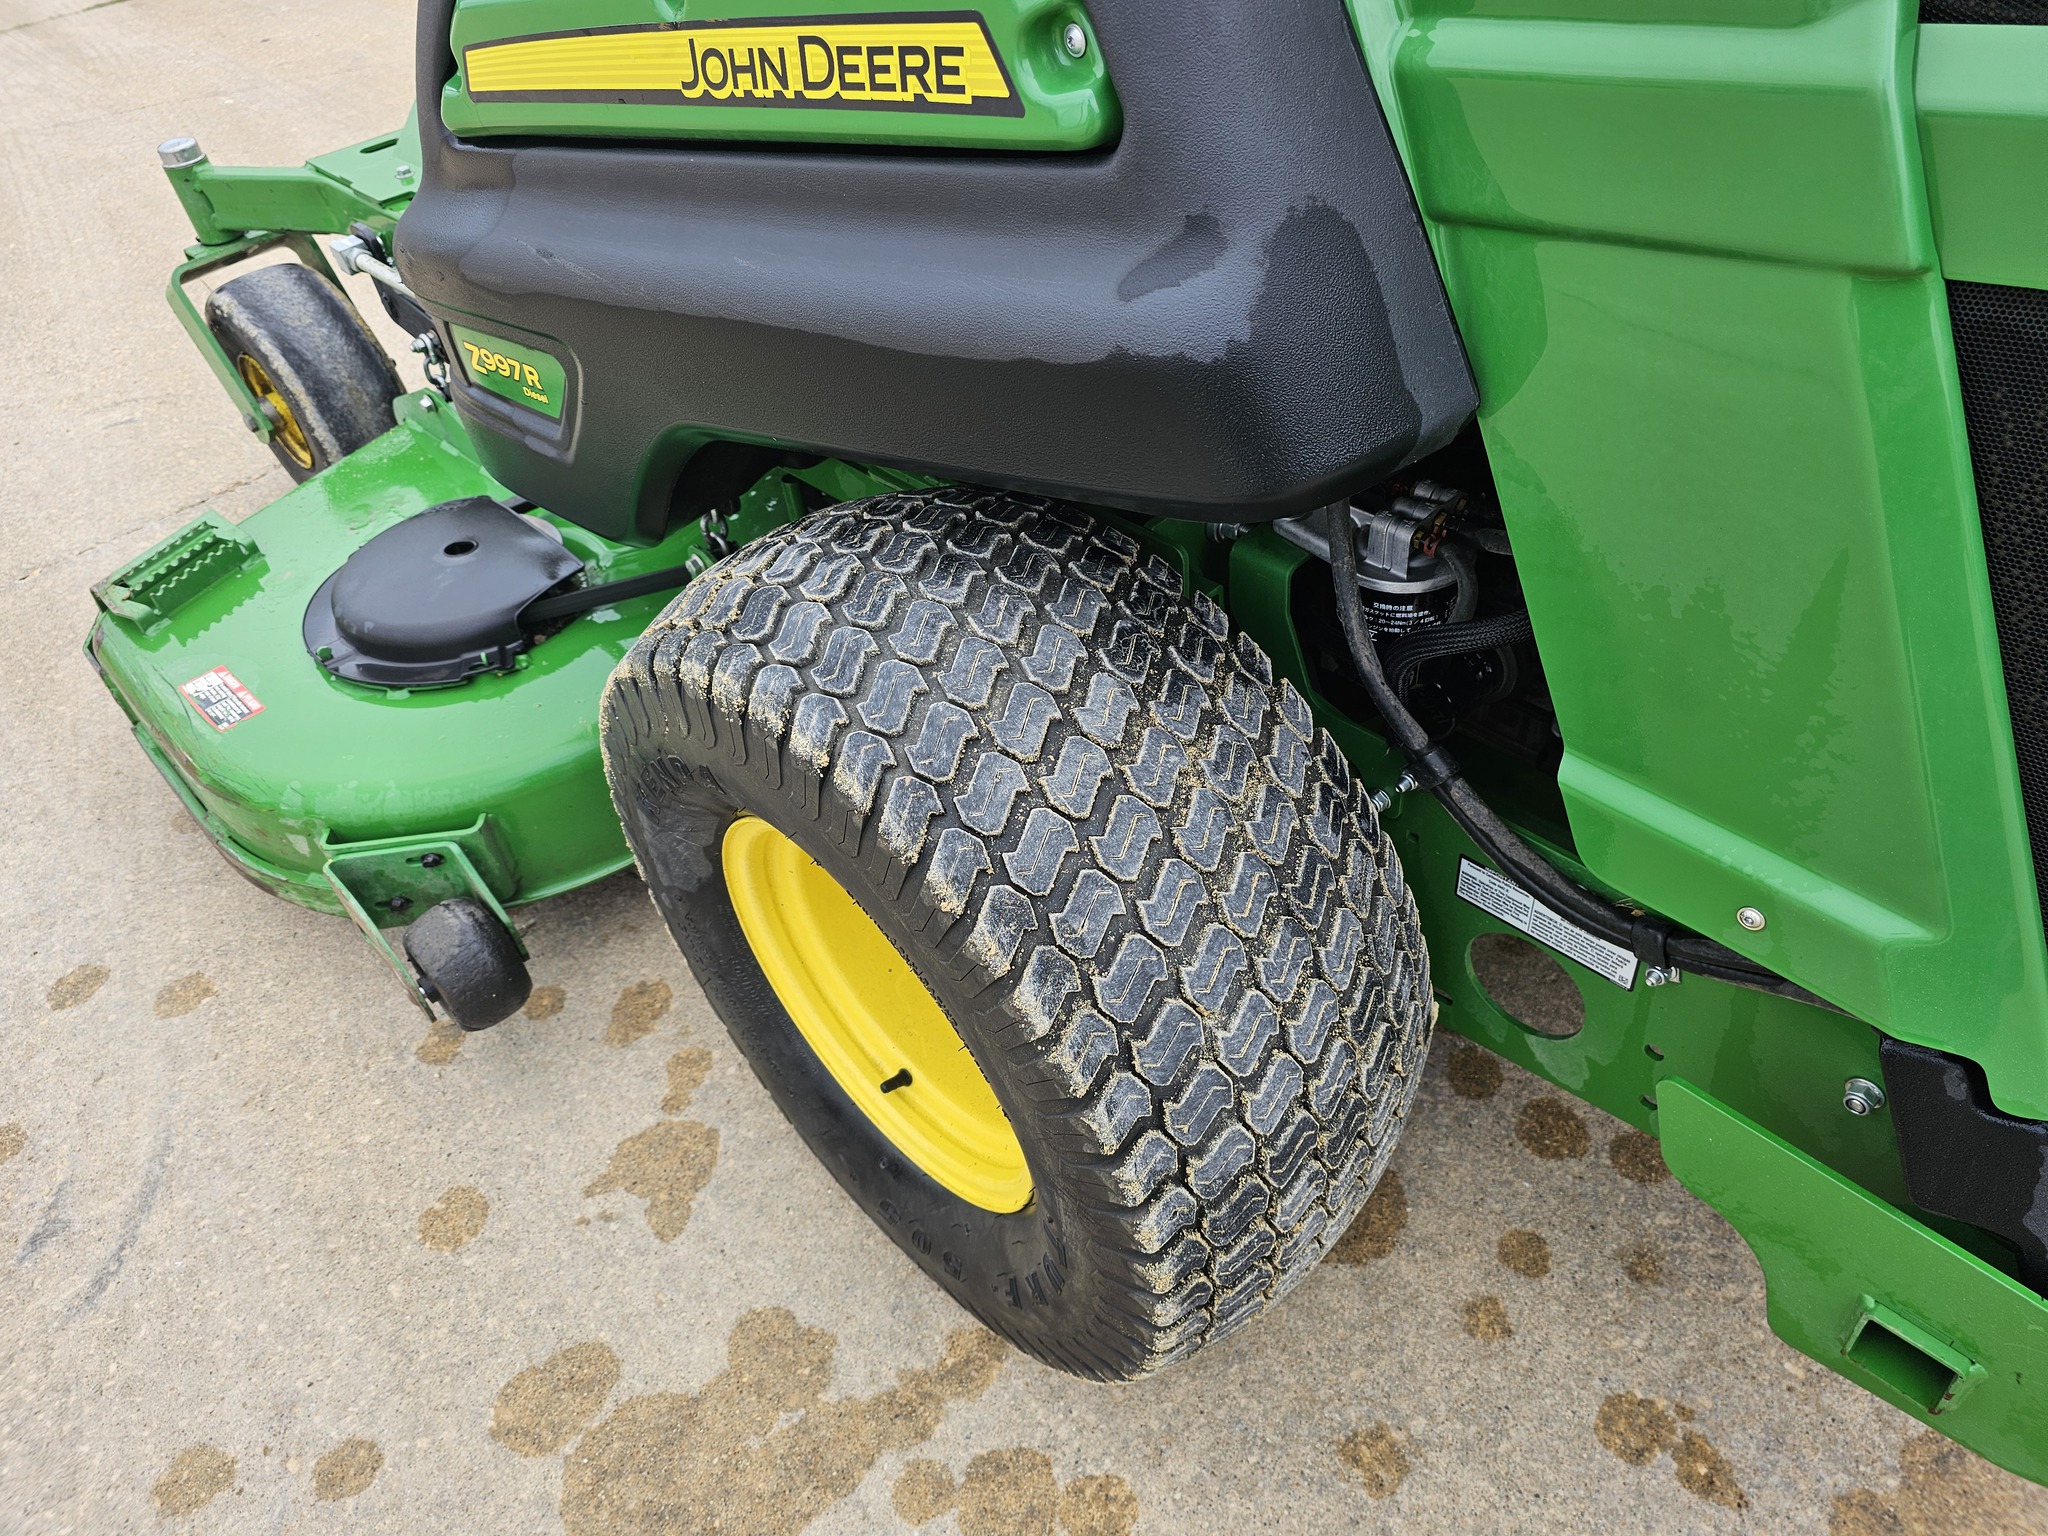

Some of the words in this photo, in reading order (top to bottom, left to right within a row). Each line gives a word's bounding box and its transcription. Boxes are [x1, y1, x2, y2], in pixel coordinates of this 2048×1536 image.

[681, 38, 789, 91] JOHN
[797, 35, 966, 95] DEERE
[522, 386, 549, 404] Diesel
